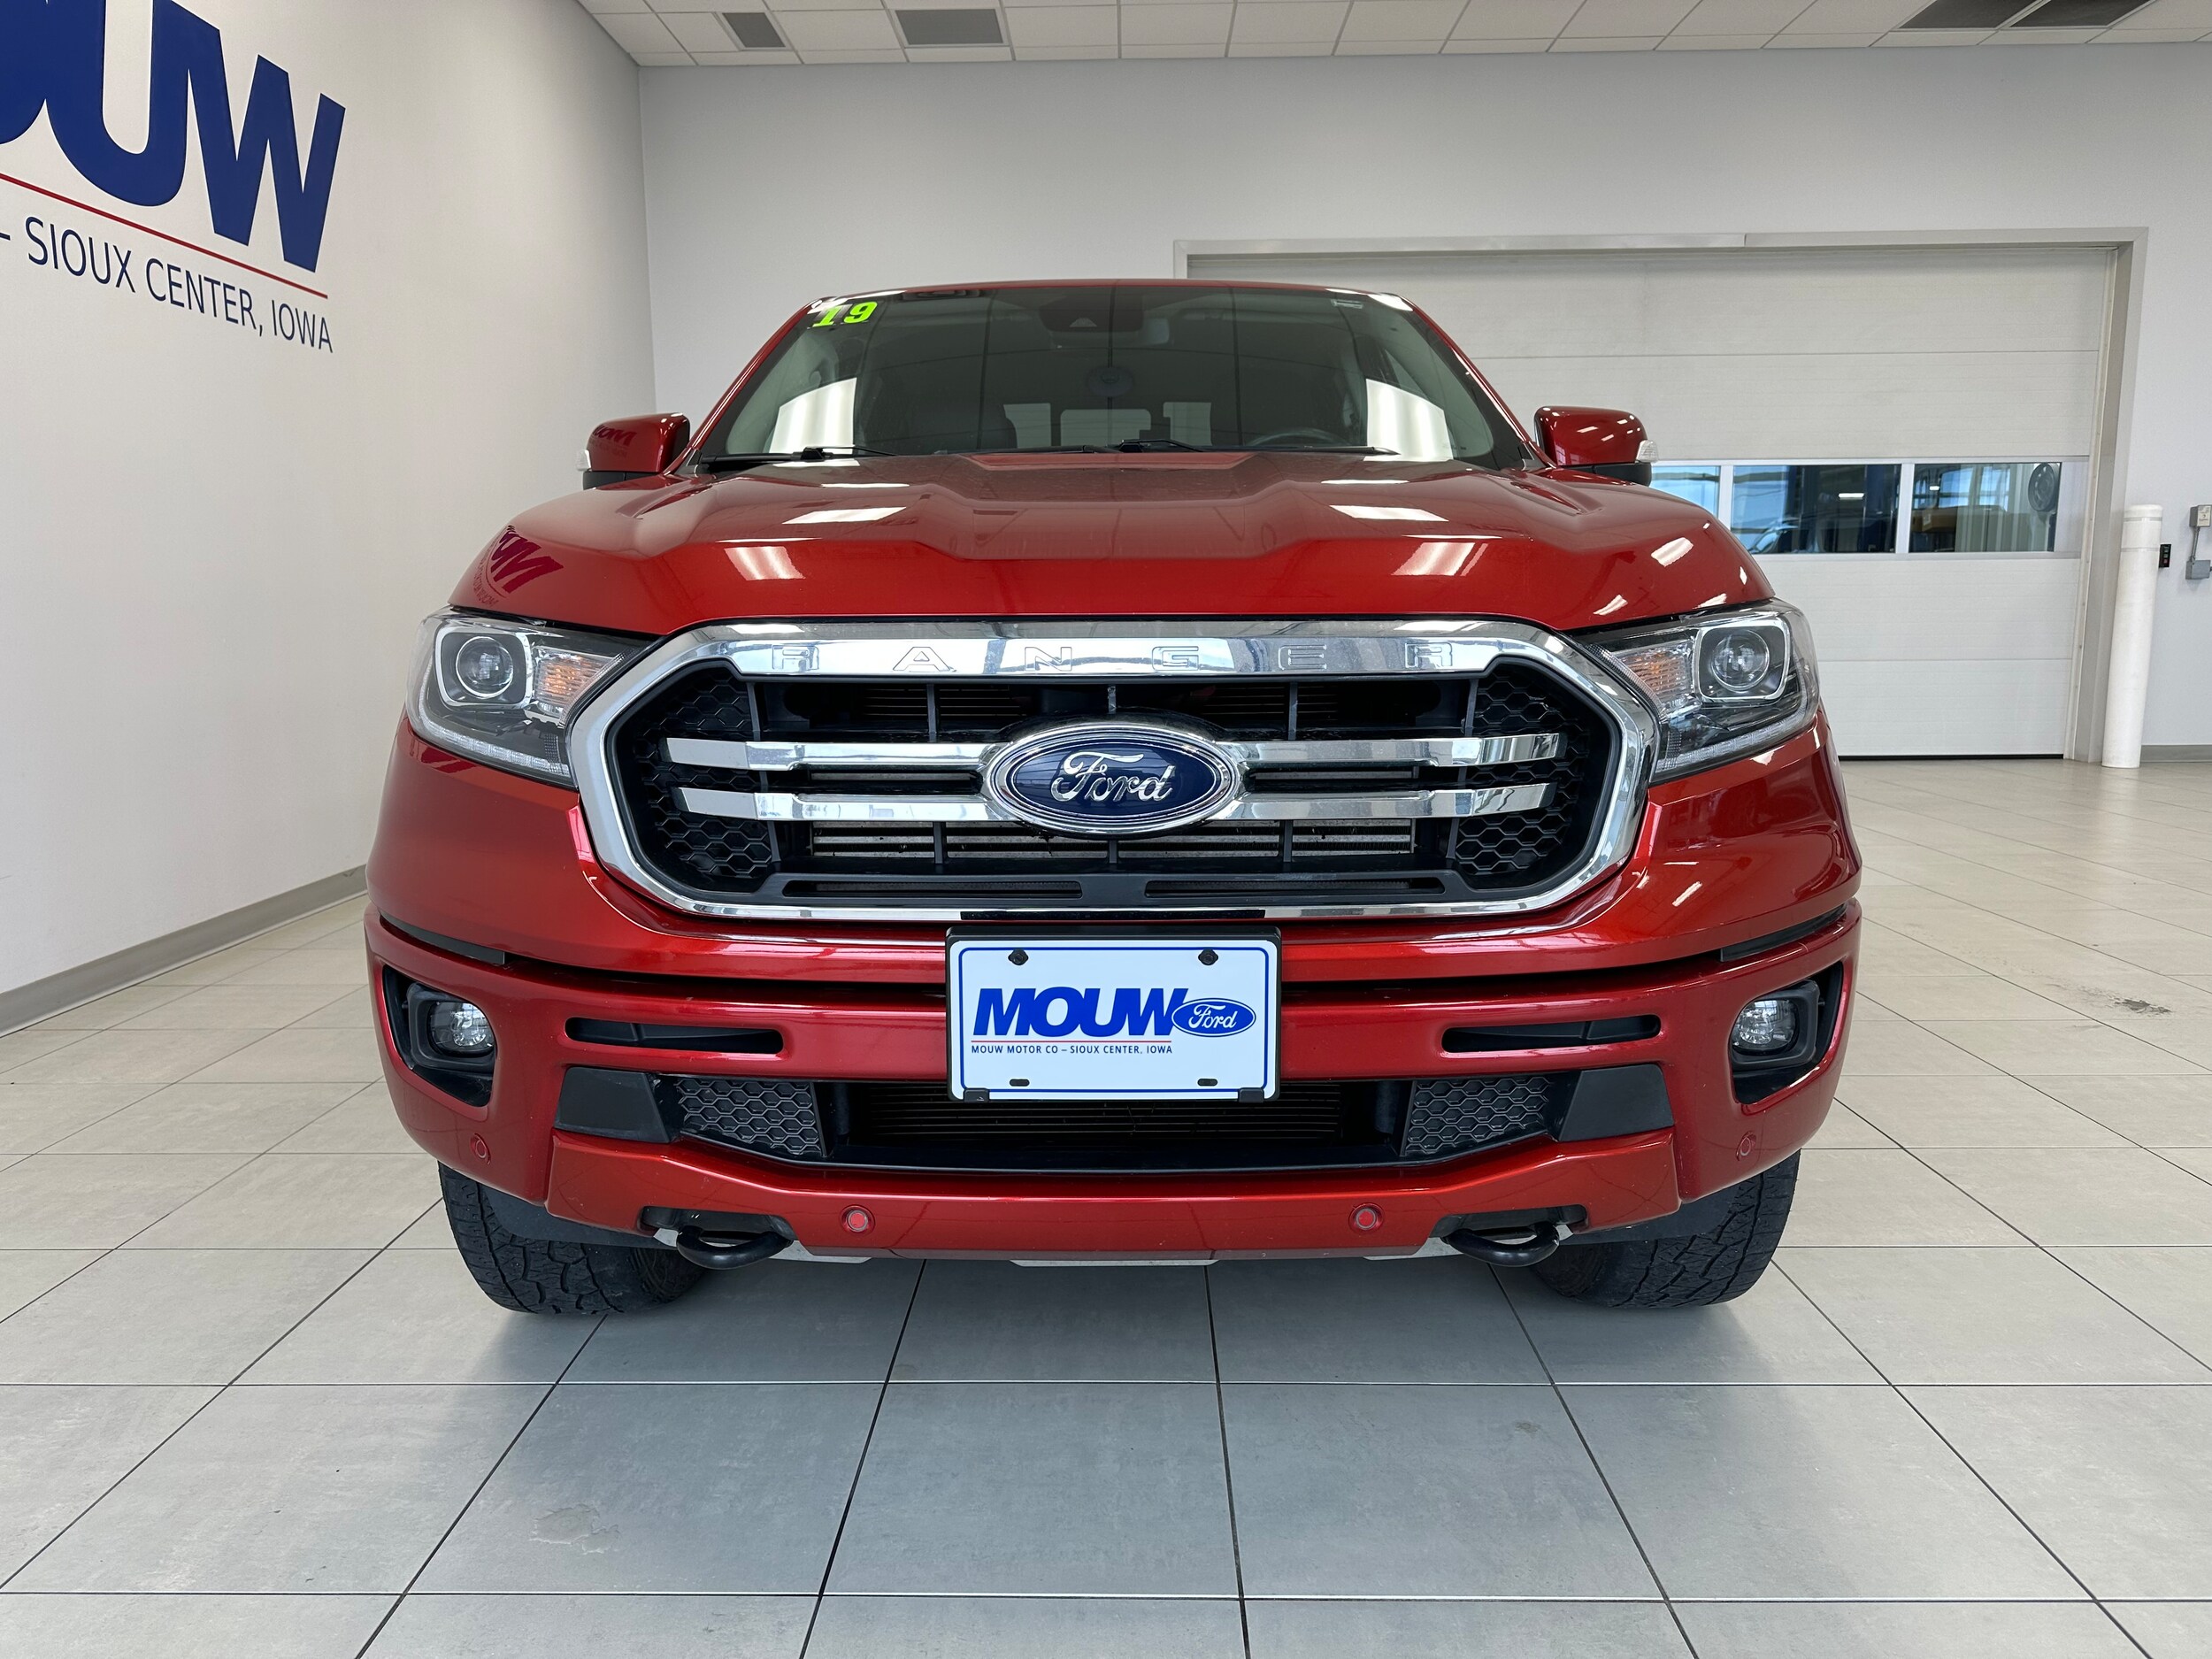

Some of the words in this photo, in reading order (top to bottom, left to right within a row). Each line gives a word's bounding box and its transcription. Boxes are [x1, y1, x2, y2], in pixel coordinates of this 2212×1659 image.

[25, 216, 135, 293] SIOUX
[145, 257, 264, 337] CENTER,
[271, 299, 334, 354] IOWA
[811, 301, 878, 327] 19
[772, 641, 1453, 672] RANGER
[1050, 751, 1176, 802] Ford
[972, 987, 1189, 1038] MOUW
[1188, 1003, 1238, 1029] Ford
[972, 1045, 1003, 1054] MOUW
[1007, 1045, 1041, 1054] MOTOR
[1045, 1045, 1058, 1054] CO
[1070, 1045, 1100, 1054] SIOUX
[1146, 1045, 1172, 1054] IOWA
